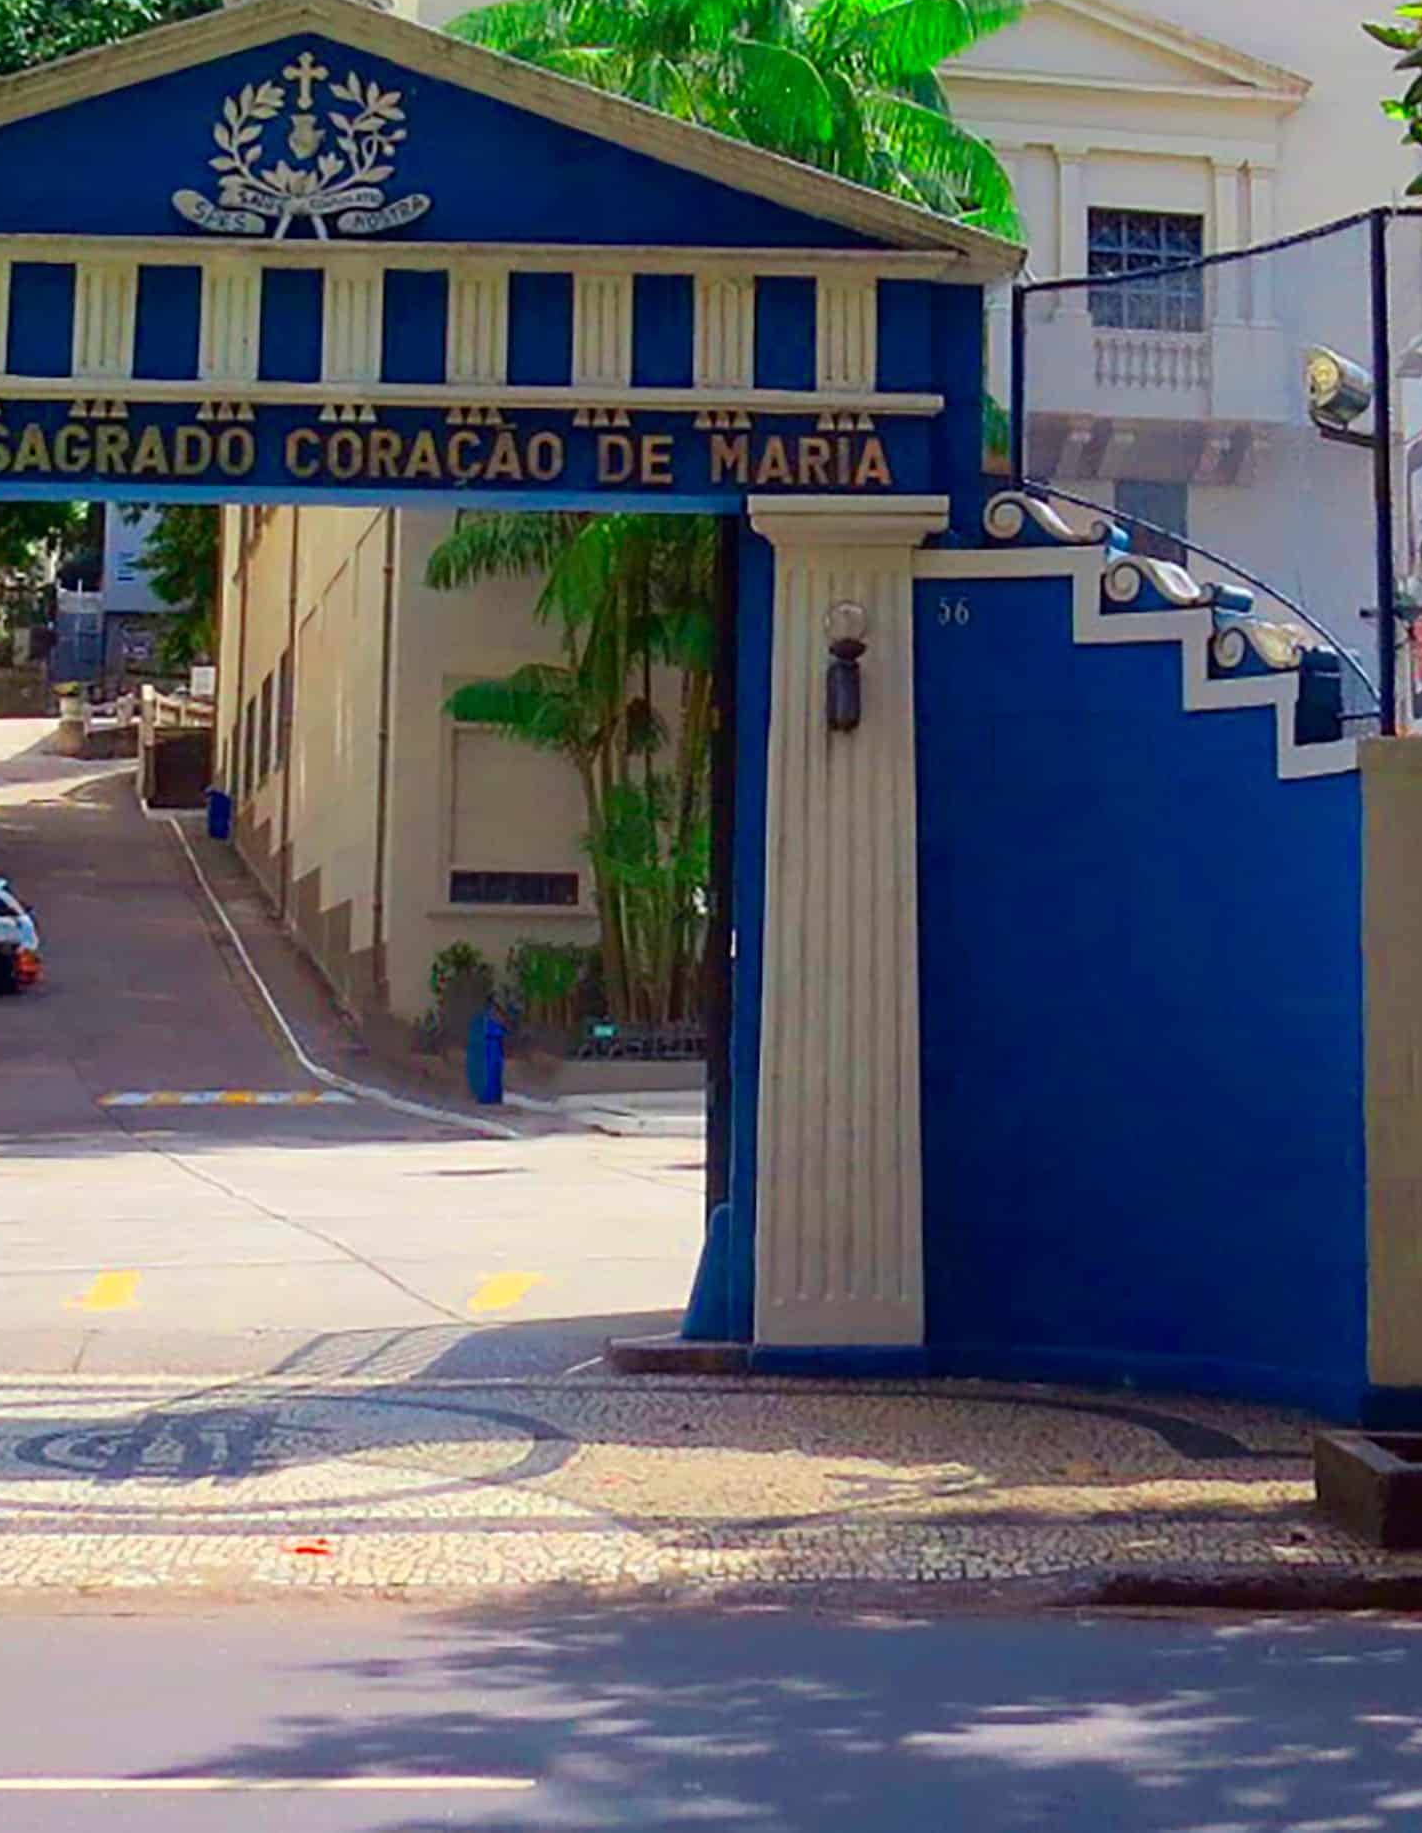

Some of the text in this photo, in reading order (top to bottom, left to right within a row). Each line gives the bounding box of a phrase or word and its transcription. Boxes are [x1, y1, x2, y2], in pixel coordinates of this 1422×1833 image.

[193, 200, 247, 231] SPES
[285, 423, 564, 489] CORAÇÃO
[597, 433, 675, 485] DE
[710, 433, 892, 487] MARIA
